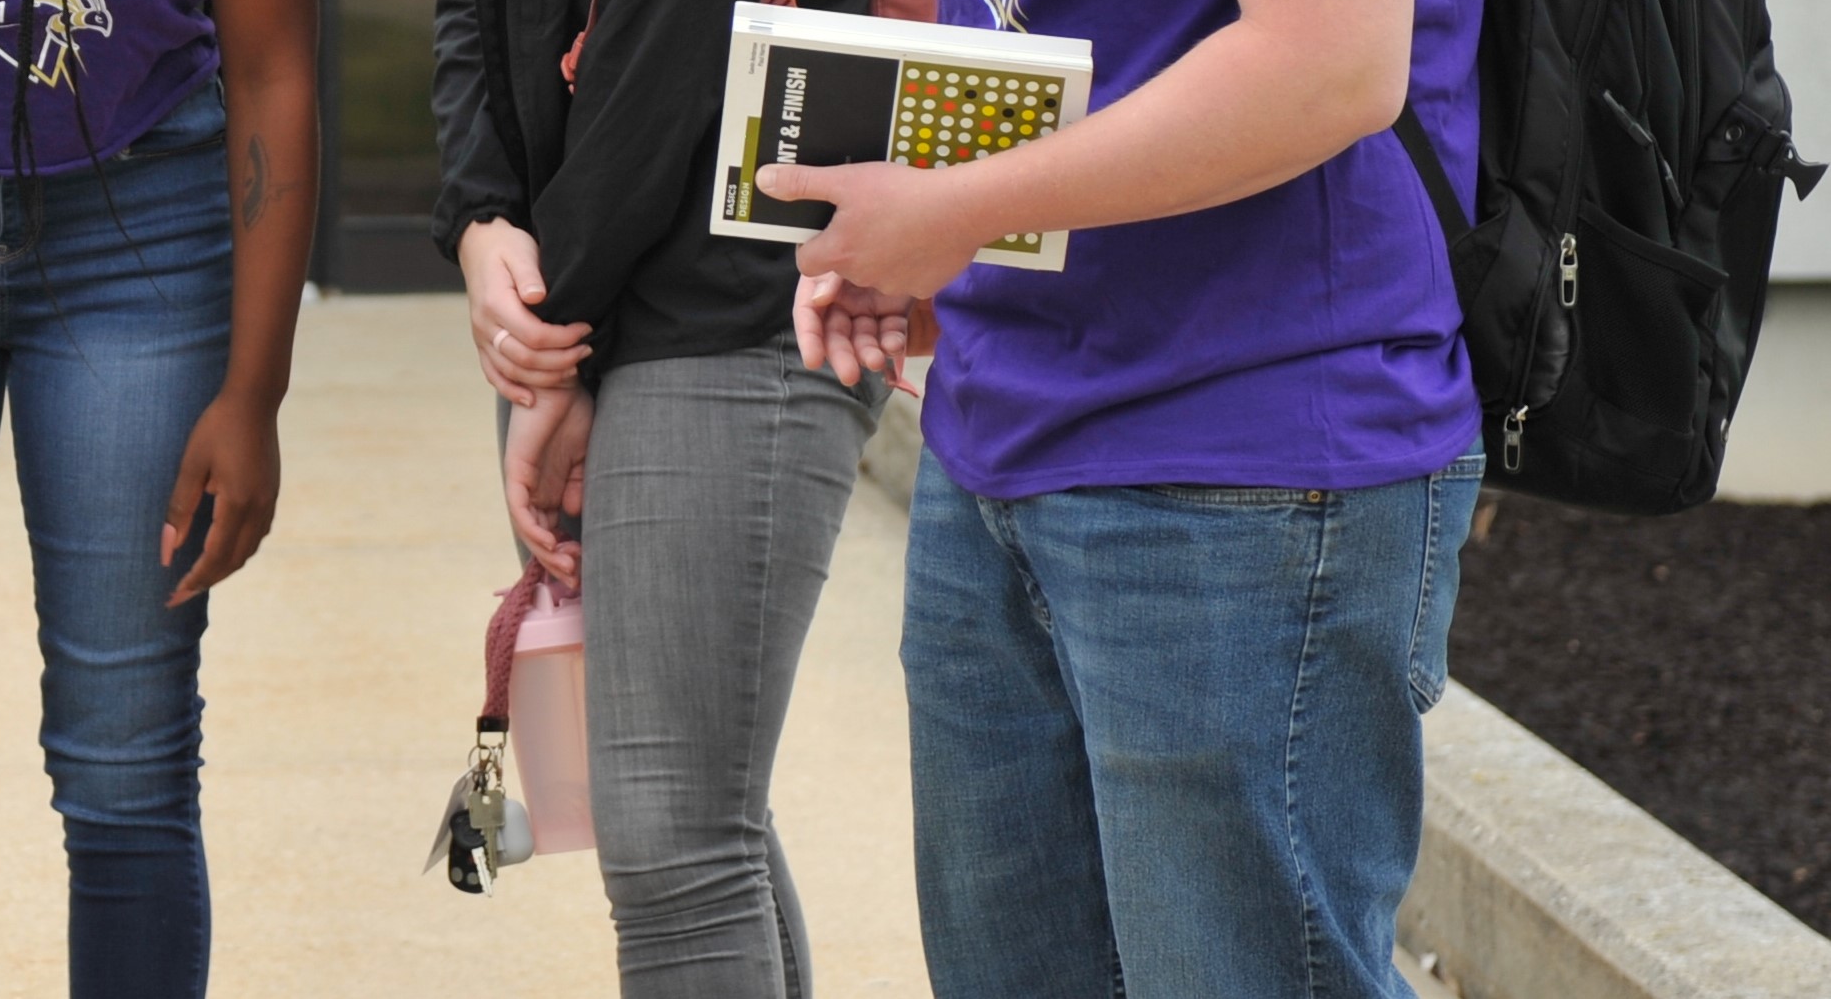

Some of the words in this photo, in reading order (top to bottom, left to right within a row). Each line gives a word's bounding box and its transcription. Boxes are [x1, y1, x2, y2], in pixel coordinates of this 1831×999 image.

[781, 67, 808, 122] FINISH
[780, 124, 801, 139] &
[725, 183, 737, 216] BASICS
[738, 181, 750, 217] DESIGN
